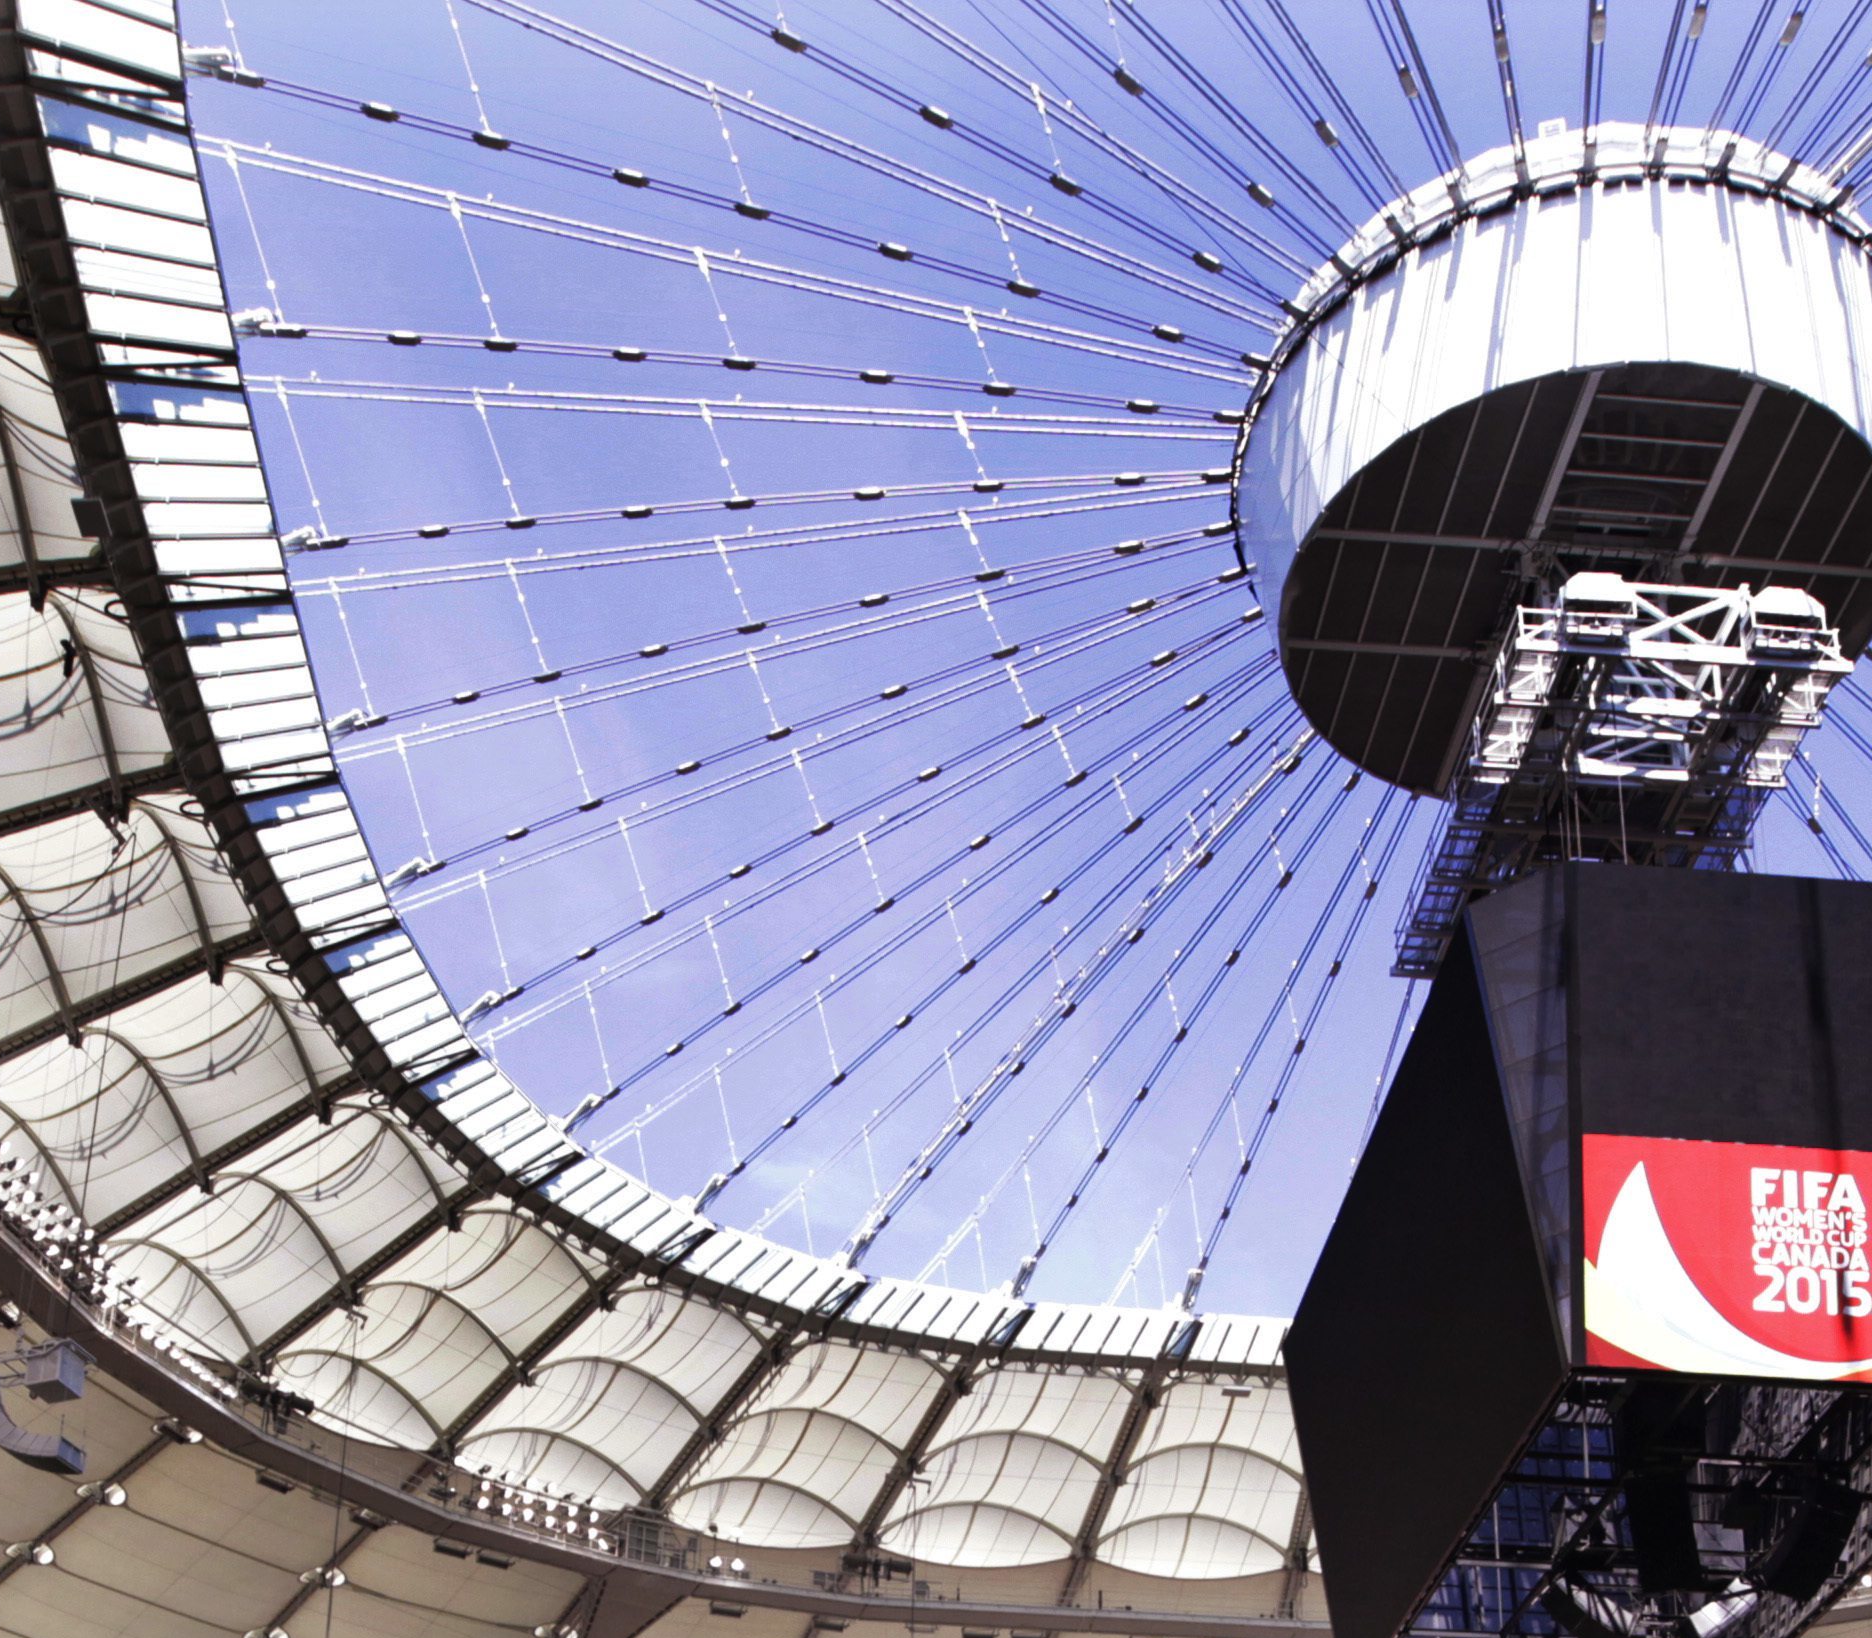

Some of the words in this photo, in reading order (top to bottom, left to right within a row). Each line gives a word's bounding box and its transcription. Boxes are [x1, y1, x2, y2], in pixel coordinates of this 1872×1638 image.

[1750, 1167, 1867, 1213] FIFA
[1751, 1206, 1869, 1233] WOMEN'S
[1751, 1225, 1825, 1245] WORLD
[1826, 1231, 1868, 1248] CUP
[1751, 1241, 1870, 1271] CANADA
